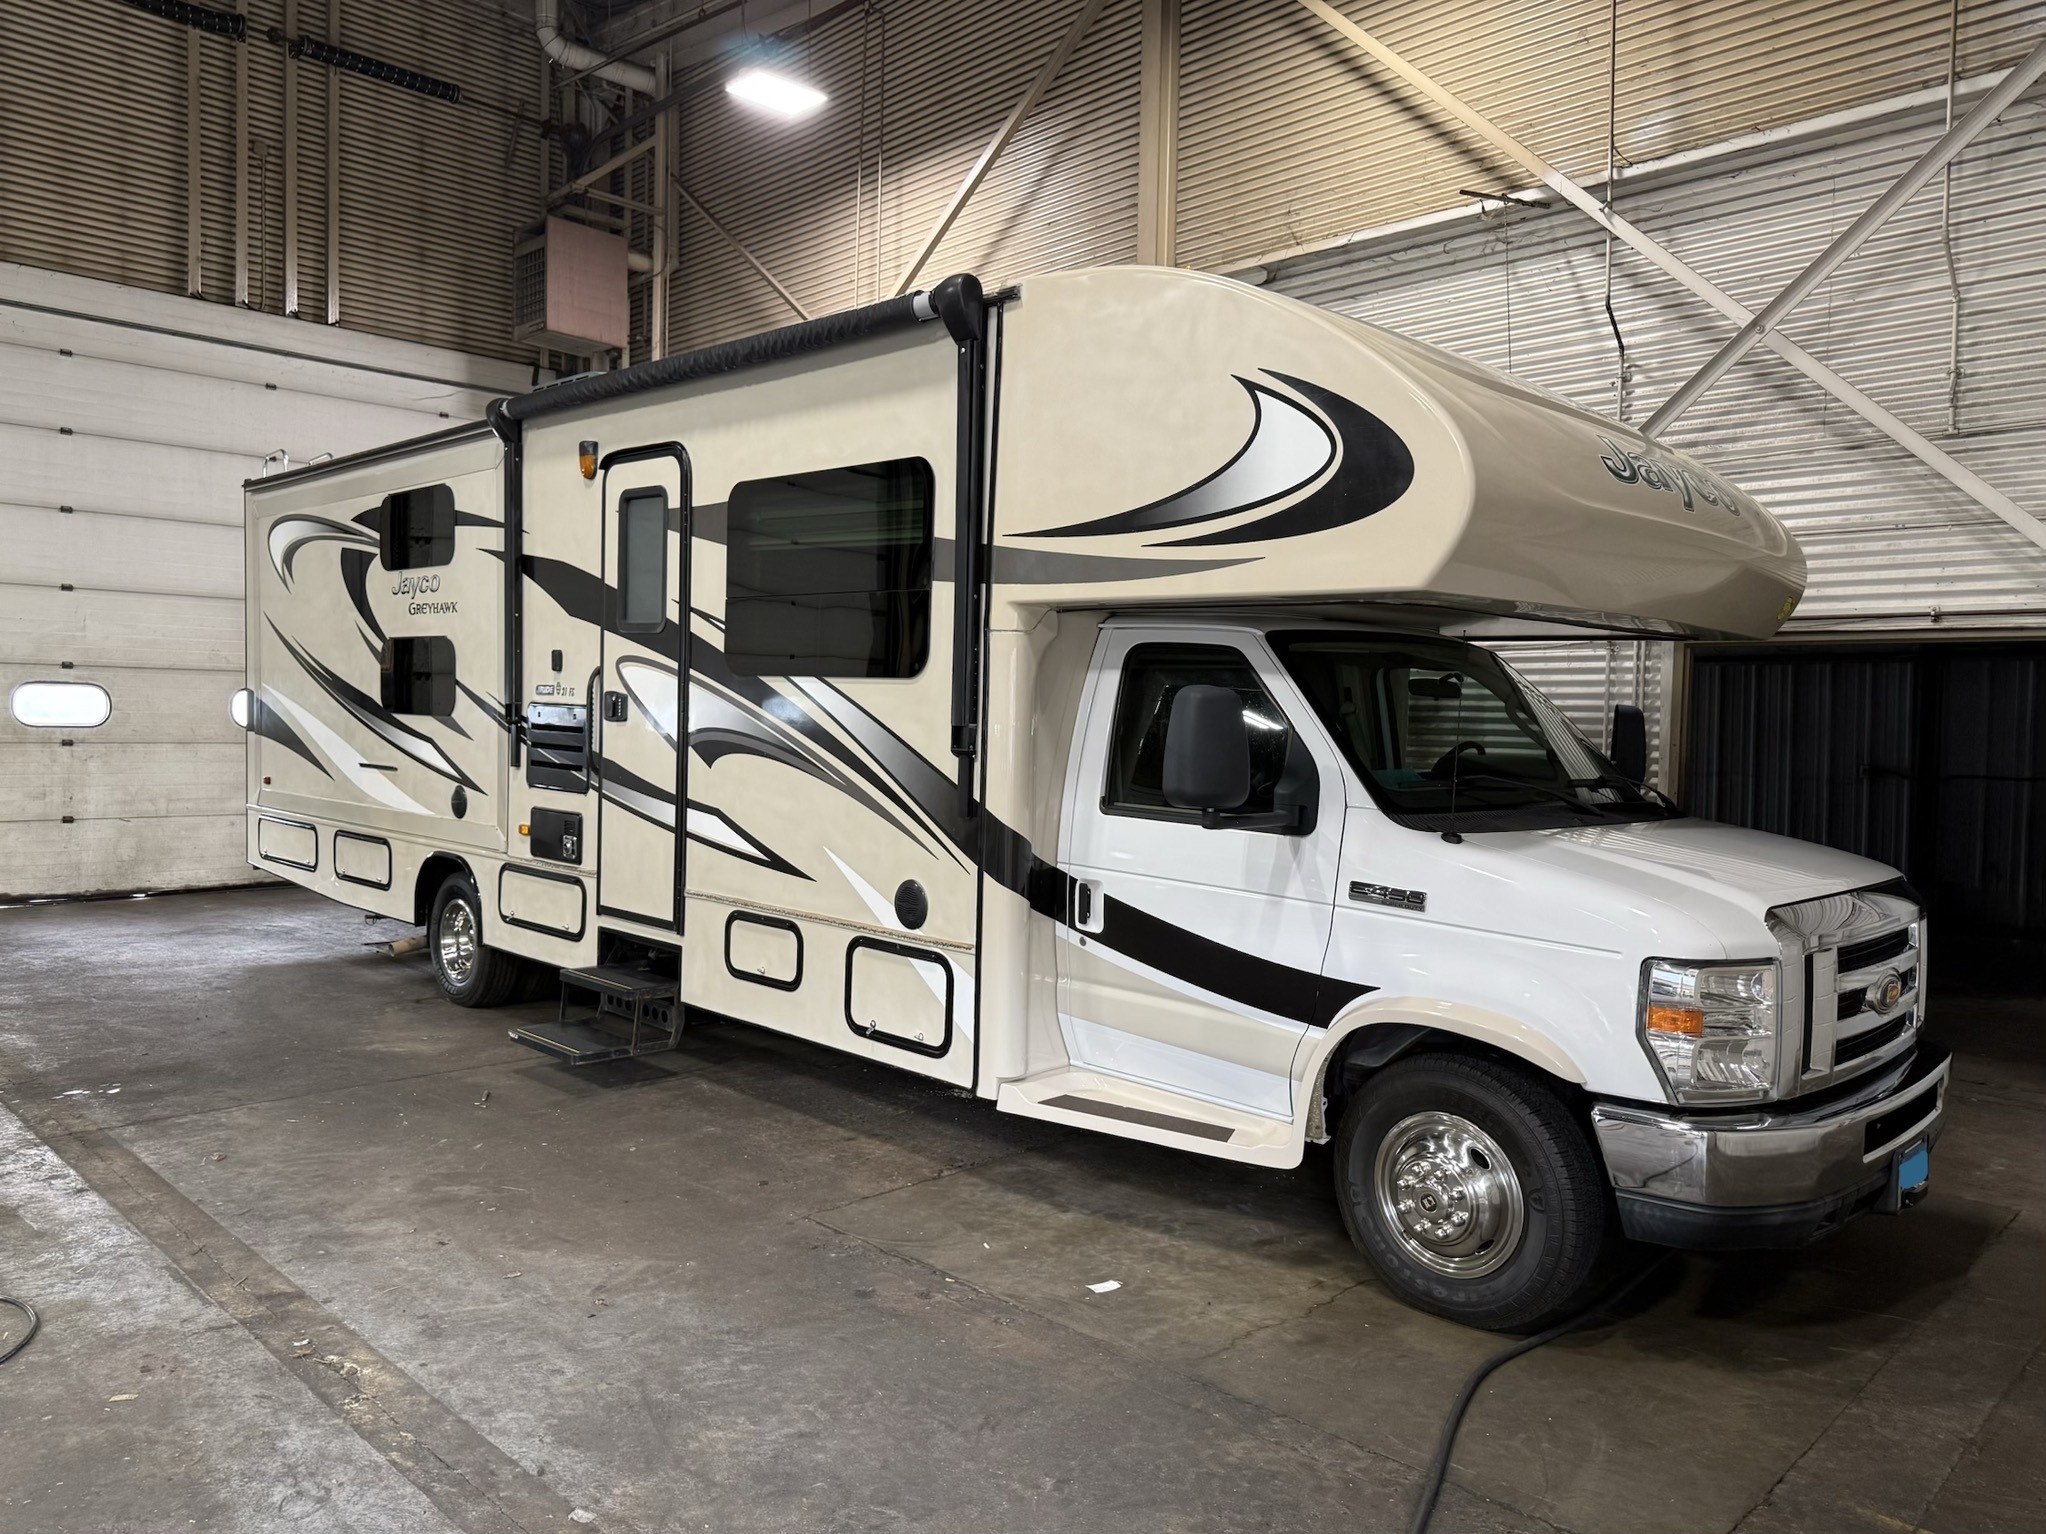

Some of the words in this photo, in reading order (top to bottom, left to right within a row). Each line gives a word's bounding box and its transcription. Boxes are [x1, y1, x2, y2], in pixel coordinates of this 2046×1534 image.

[1596, 433, 1741, 517] Jayco
[391, 571, 441, 600] Jayco
[408, 602, 458, 616] GREYHAWK
